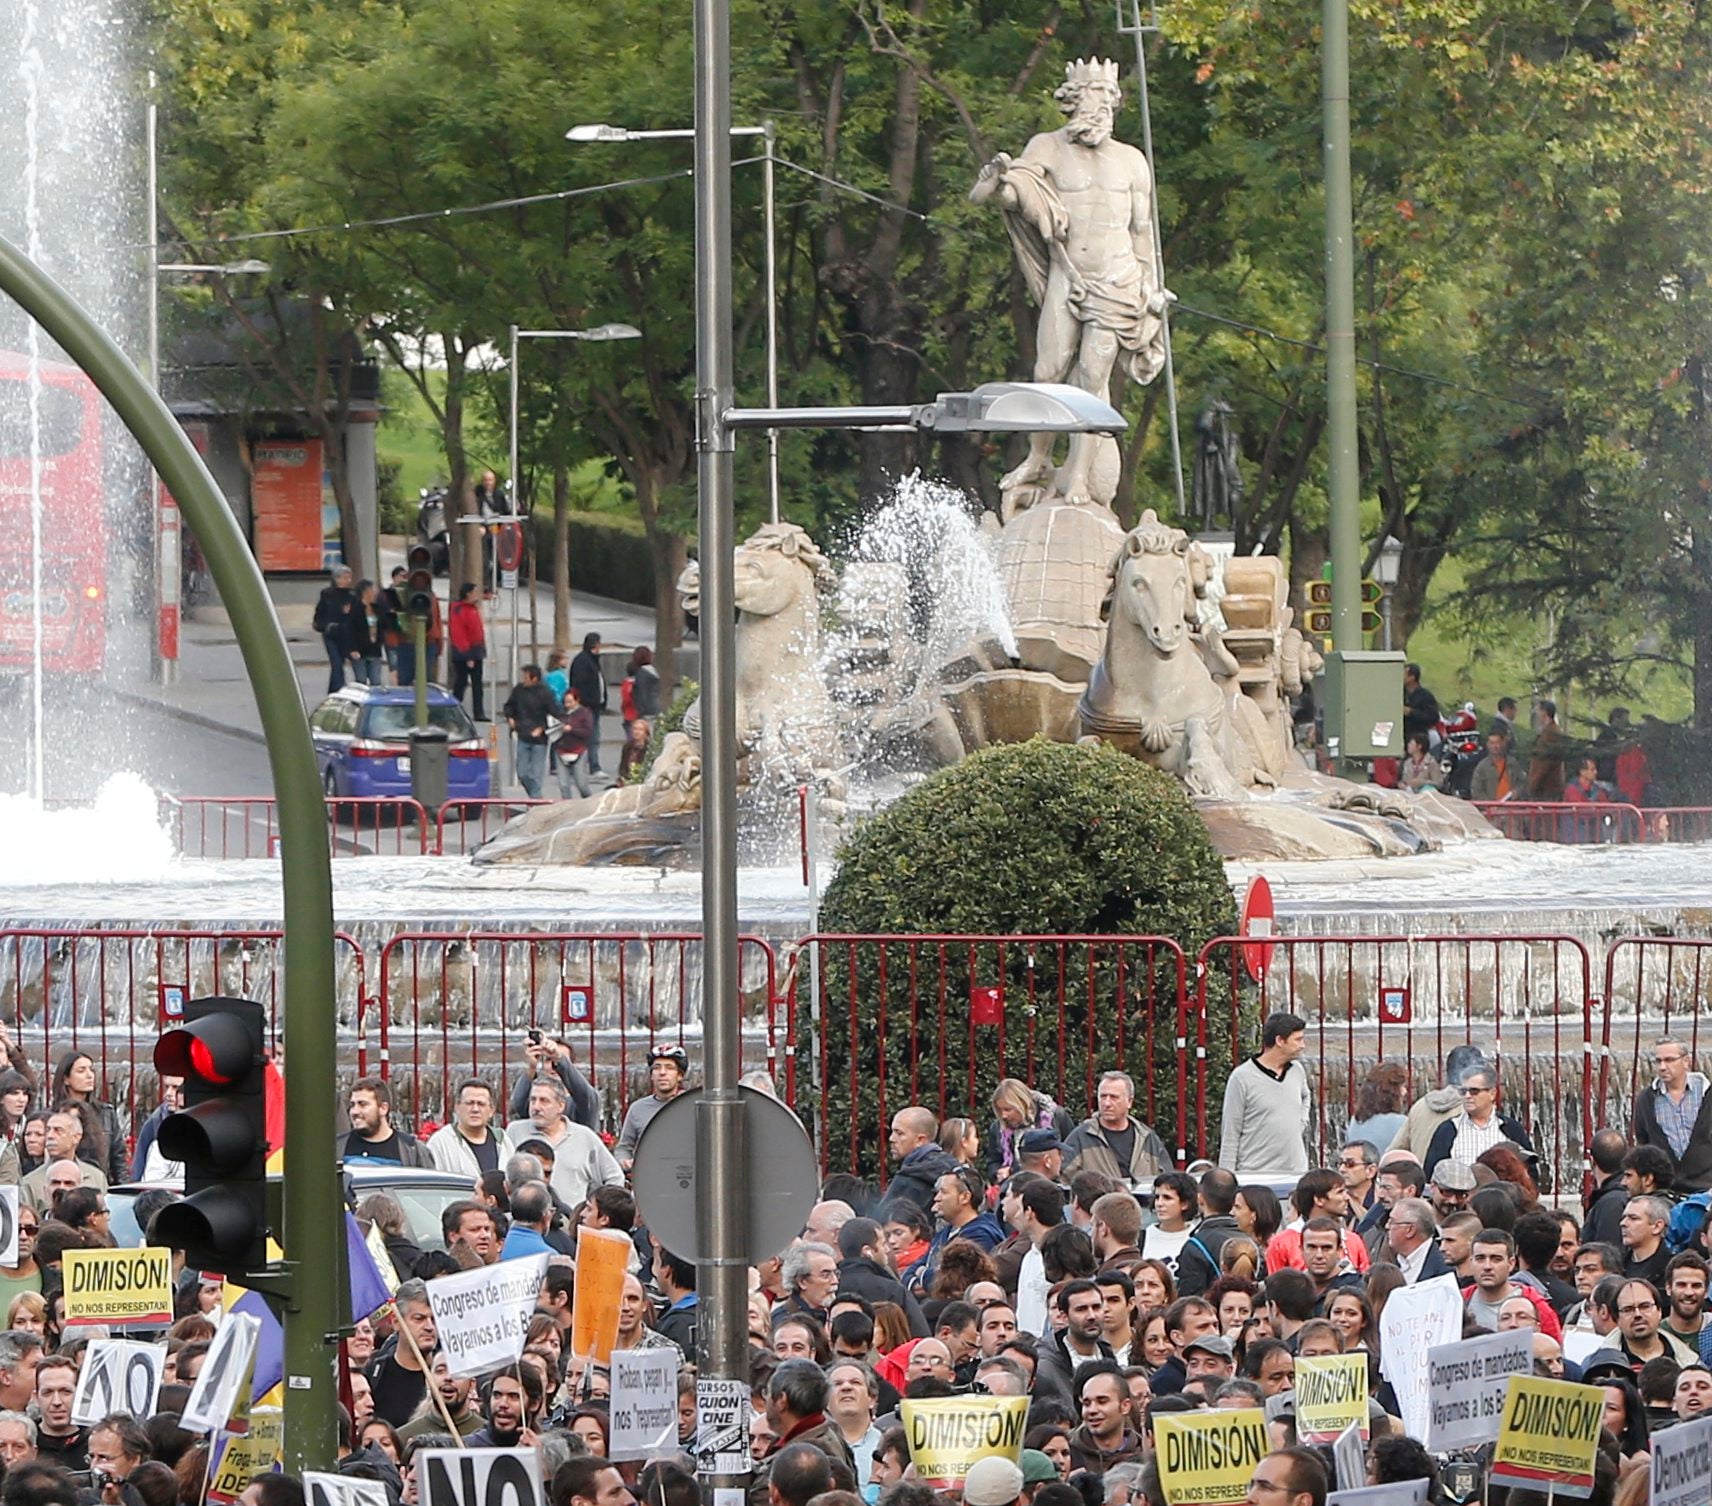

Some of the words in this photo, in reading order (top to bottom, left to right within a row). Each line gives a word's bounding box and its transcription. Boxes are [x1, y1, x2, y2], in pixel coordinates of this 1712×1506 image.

[72, 1254, 169, 1293] DIMISIÓN!
[69, 1303, 84, 1316] ¡NO
[86, 1302, 104, 1314] NOS
[105, 1300, 169, 1314] REPRESENTAN!
[433, 1284, 486, 1321] Congreso
[487, 1280, 499, 1304] de
[442, 1317, 492, 1355] Vayamos
[495, 1323, 502, 1339] a
[504, 1315, 519, 1337] los
[697, 1382, 735, 1393] CURSOS
[1299, 1361, 1365, 1407] DIMISIÓN!
[1430, 1357, 1470, 1392] Congreso
[1471, 1357, 1483, 1378] de
[699, 1396, 739, 1409] GUION
[702, 1412, 735, 1424] CINE
[1432, 1399, 1470, 1431] Vayamos
[1472, 1401, 1478, 1416] a
[1479, 1393, 1494, 1416] los
[1509, 1391, 1604, 1442] DIMISIÓN!
[614, 1411, 631, 1431] nos
[913, 1407, 1026, 1451] DIMISIÓN!
[1167, 1418, 1268, 1474] DIMISIÓN!
[1500, 1446, 1518, 1461] ¡NO
[1519, 1448, 1538, 1464] NOS
[927, 1464, 949, 1477] NOS
[1185, 1486, 1204, 1501] NOS
